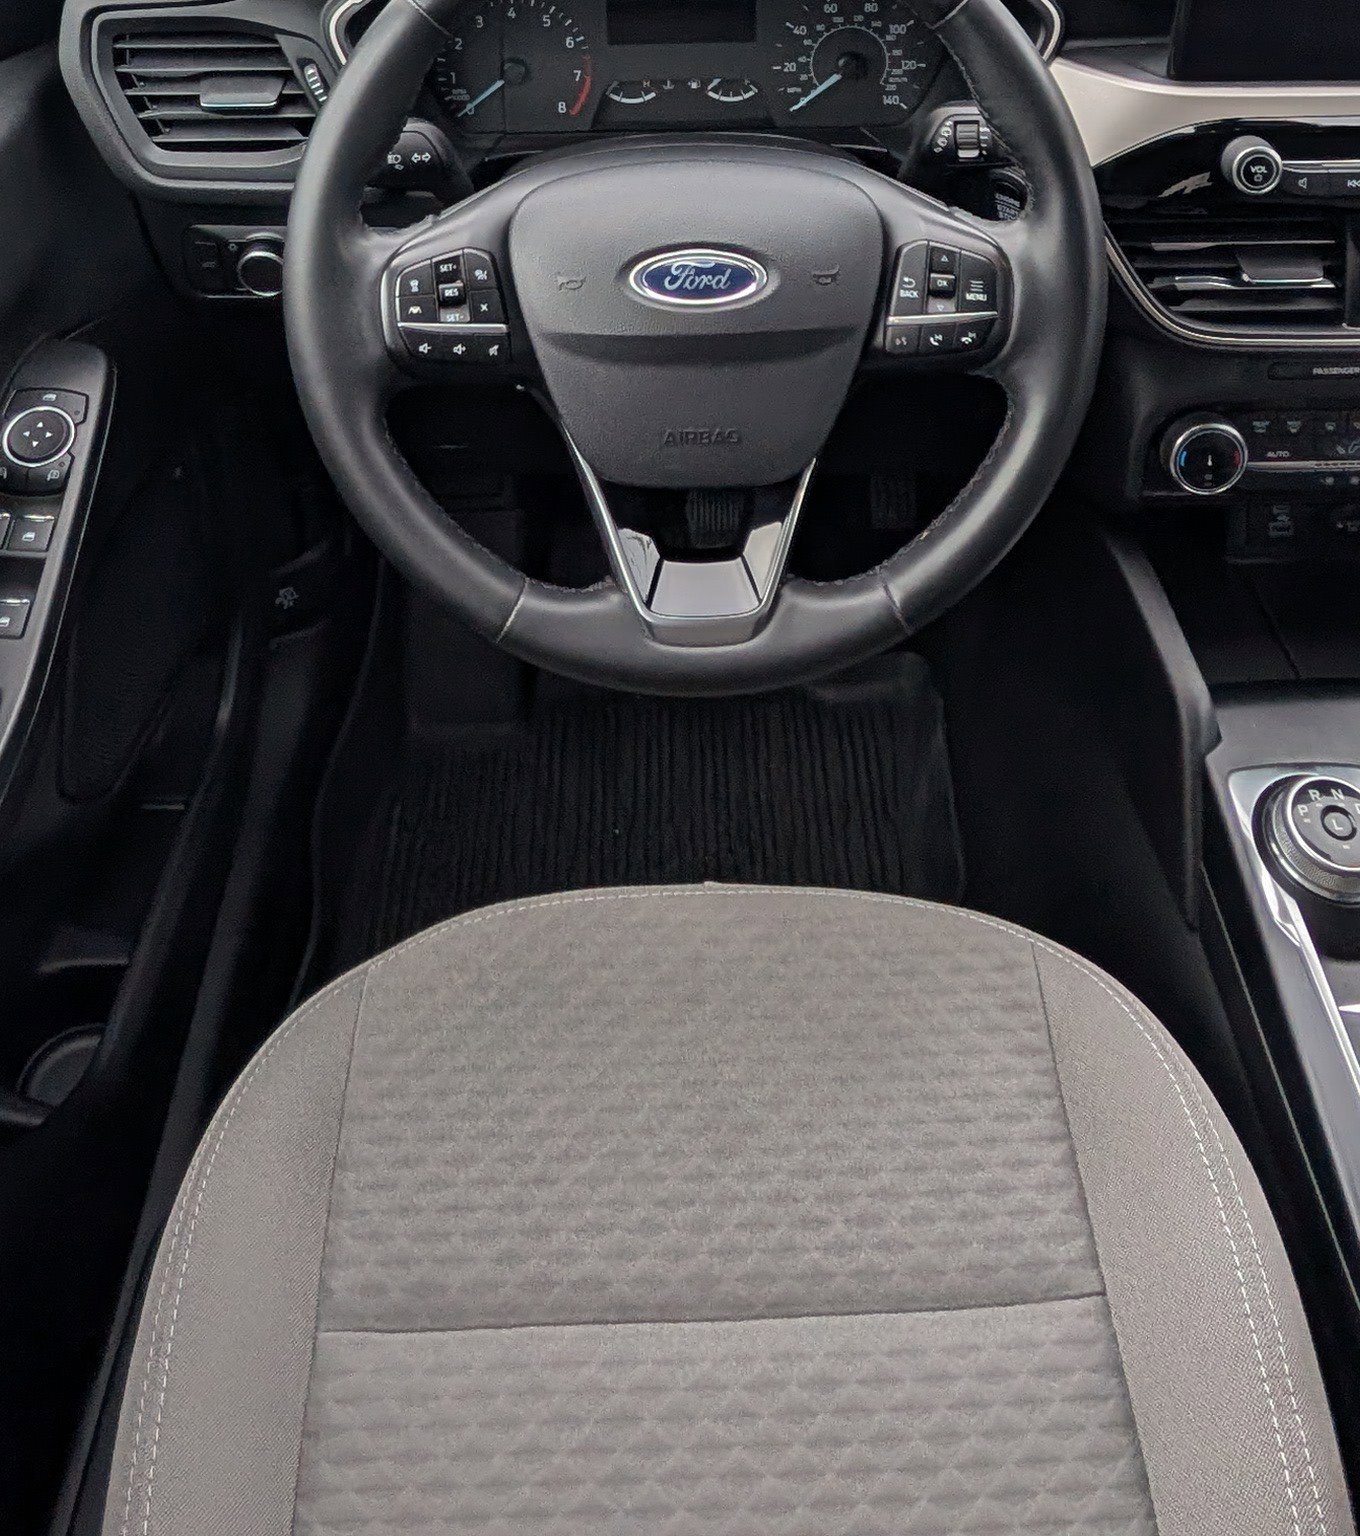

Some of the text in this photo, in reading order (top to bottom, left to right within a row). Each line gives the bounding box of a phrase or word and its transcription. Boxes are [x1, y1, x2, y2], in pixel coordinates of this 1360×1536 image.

[507, 6, 516, 19] 4
[823, 3, 838, 13] 60
[864, 2, 878, 13] 80
[475, 15, 484, 29] 3
[542, 14, 551, 27] 5
[793, 25, 807, 35] 40
[889, 24, 907, 35] 100
[454, 37, 463, 51] 2
[565, 36, 575, 49] 6
[783, 62, 796, 73] 20
[901, 60, 917, 70] 120
[450, 71, 456, 84] 1
[573, 69, 582, 82] 7
[883, 95, 900, 105] 140
[558, 101, 567, 114] 8
[1250, 165, 1268, 174] VOL
[664, 261, 732, 291] Ford
[936, 279, 948, 288] OK
[444, 288, 459, 297] RES
[900, 289, 919, 299] BACK
[965, 293, 987, 302] MENU
[1313, 366, 1360, 375] PASSENGER
[663, 427, 741, 446] AIRBAG
[1266, 450, 1291, 458] AUTO
[1308, 789, 1321, 801] R
[1331, 788, 1344, 800] N
[1297, 804, 1309, 816] P
[1332, 818, 1343, 830] L
